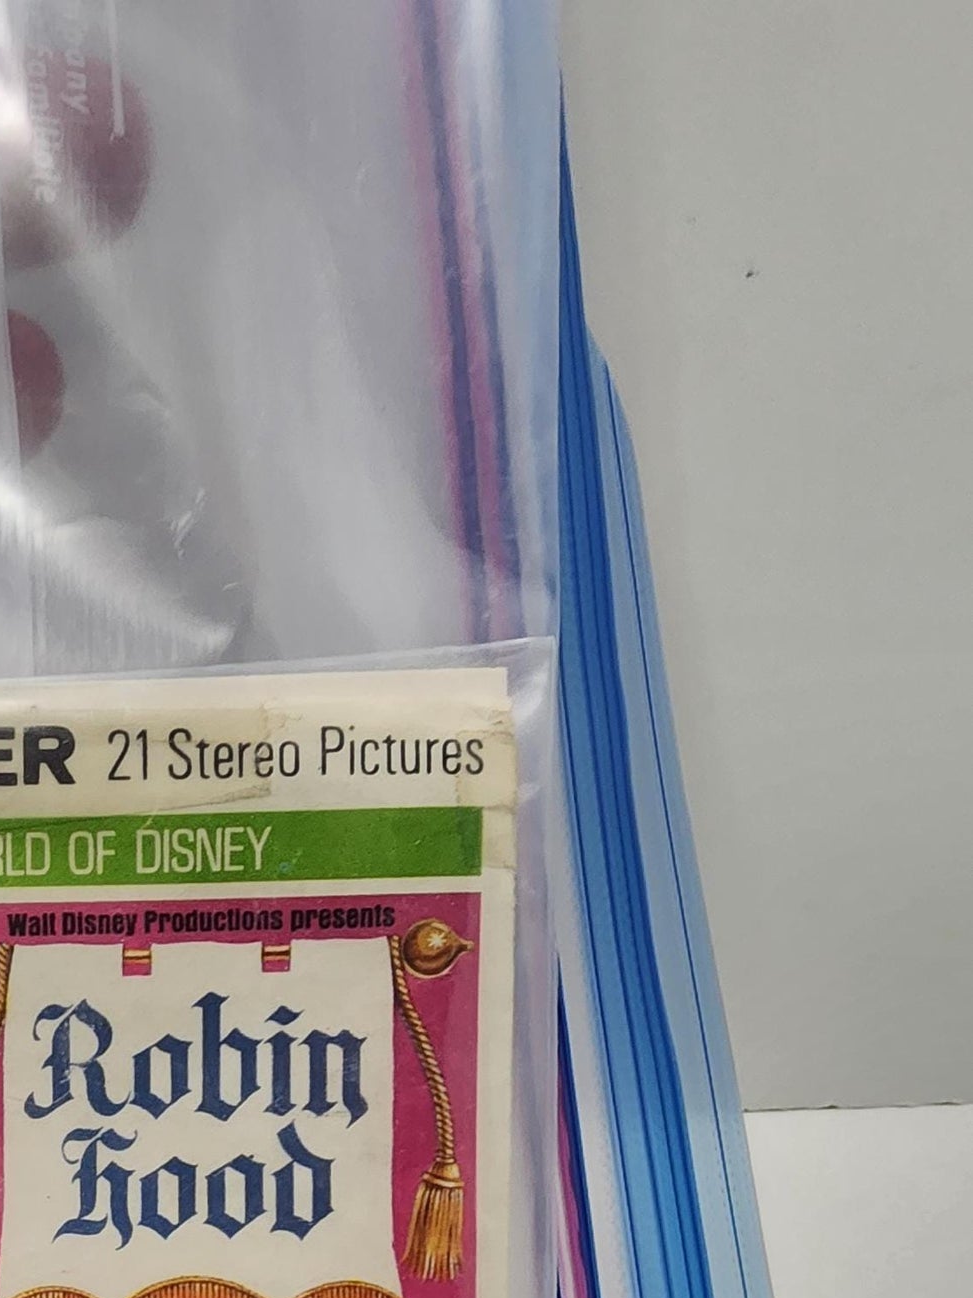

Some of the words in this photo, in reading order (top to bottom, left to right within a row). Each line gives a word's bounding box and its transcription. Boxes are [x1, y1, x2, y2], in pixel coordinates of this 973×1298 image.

[107, 728, 149, 782] 21
[167, 727, 301, 781] Stereo
[319, 725, 485, 777] Pictures
[68, 828, 117, 875] OF
[135, 825, 272, 875] DISNEY
[7, 911, 57, 938] Walt
[61, 909, 136, 938] Disney
[144, 907, 284, 935] Productions
[290, 904, 397, 933] presents
[22, 991, 370, 1129] Robin
[51, 1120, 337, 1251] Hood
